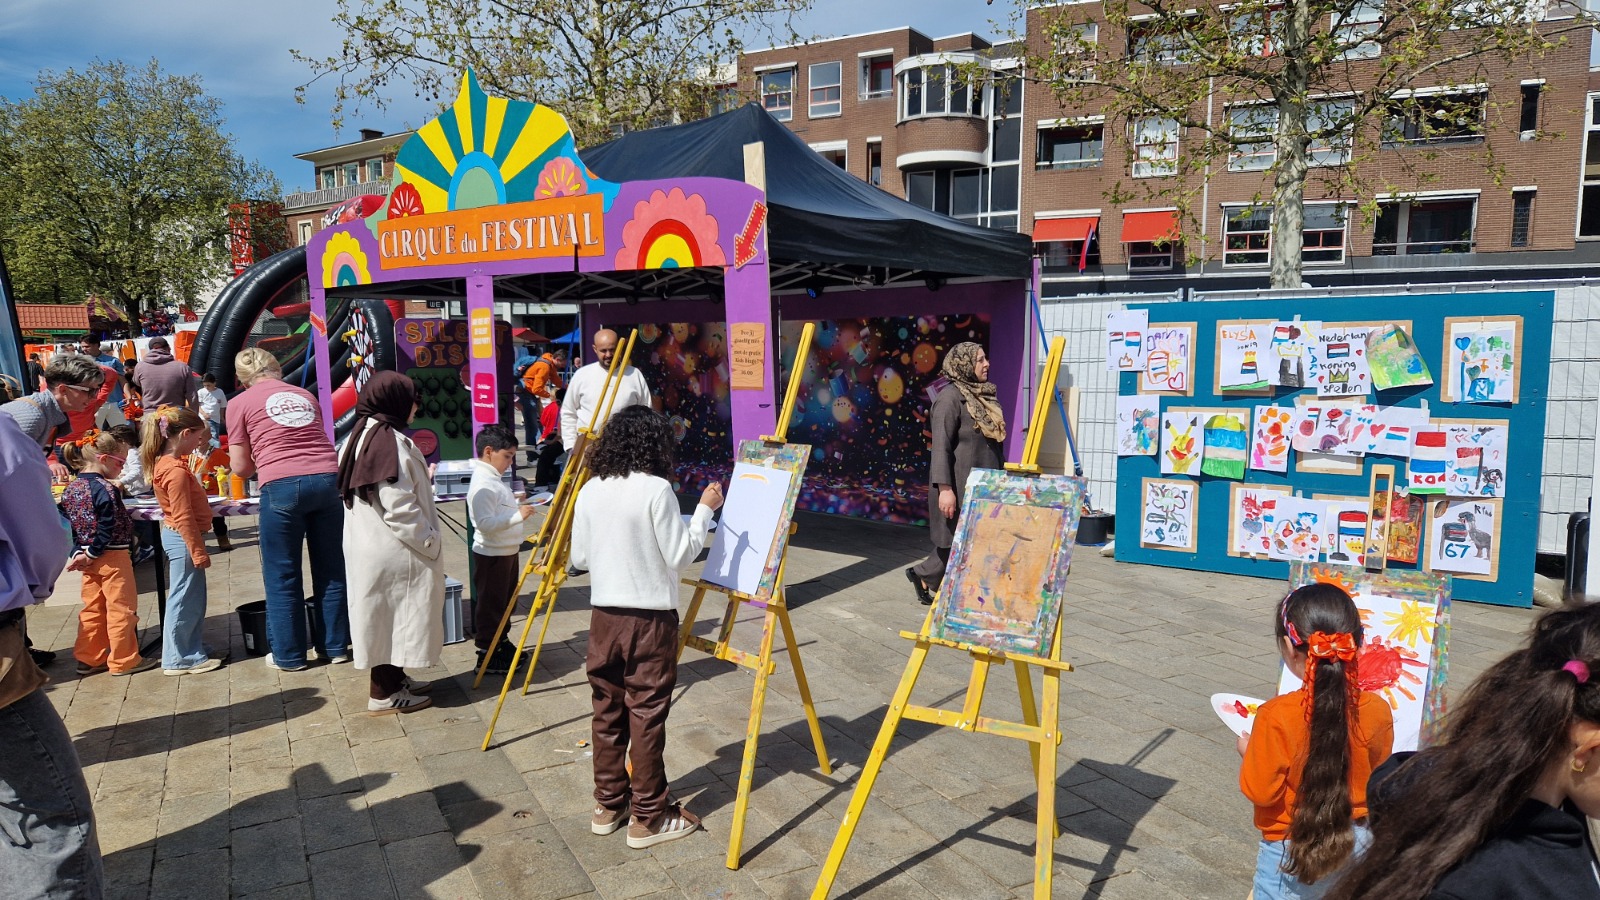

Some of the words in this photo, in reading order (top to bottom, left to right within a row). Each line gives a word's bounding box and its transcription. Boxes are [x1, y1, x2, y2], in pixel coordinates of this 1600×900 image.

[381, 225, 457, 261] CIRQUE
[461, 233, 477, 253] du
[481, 212, 599, 253] FESTIVAL
[405, 321, 509, 345] SILET
[1318, 332, 1368, 343] Nederlan
[1445, 543, 1471, 559] 67
